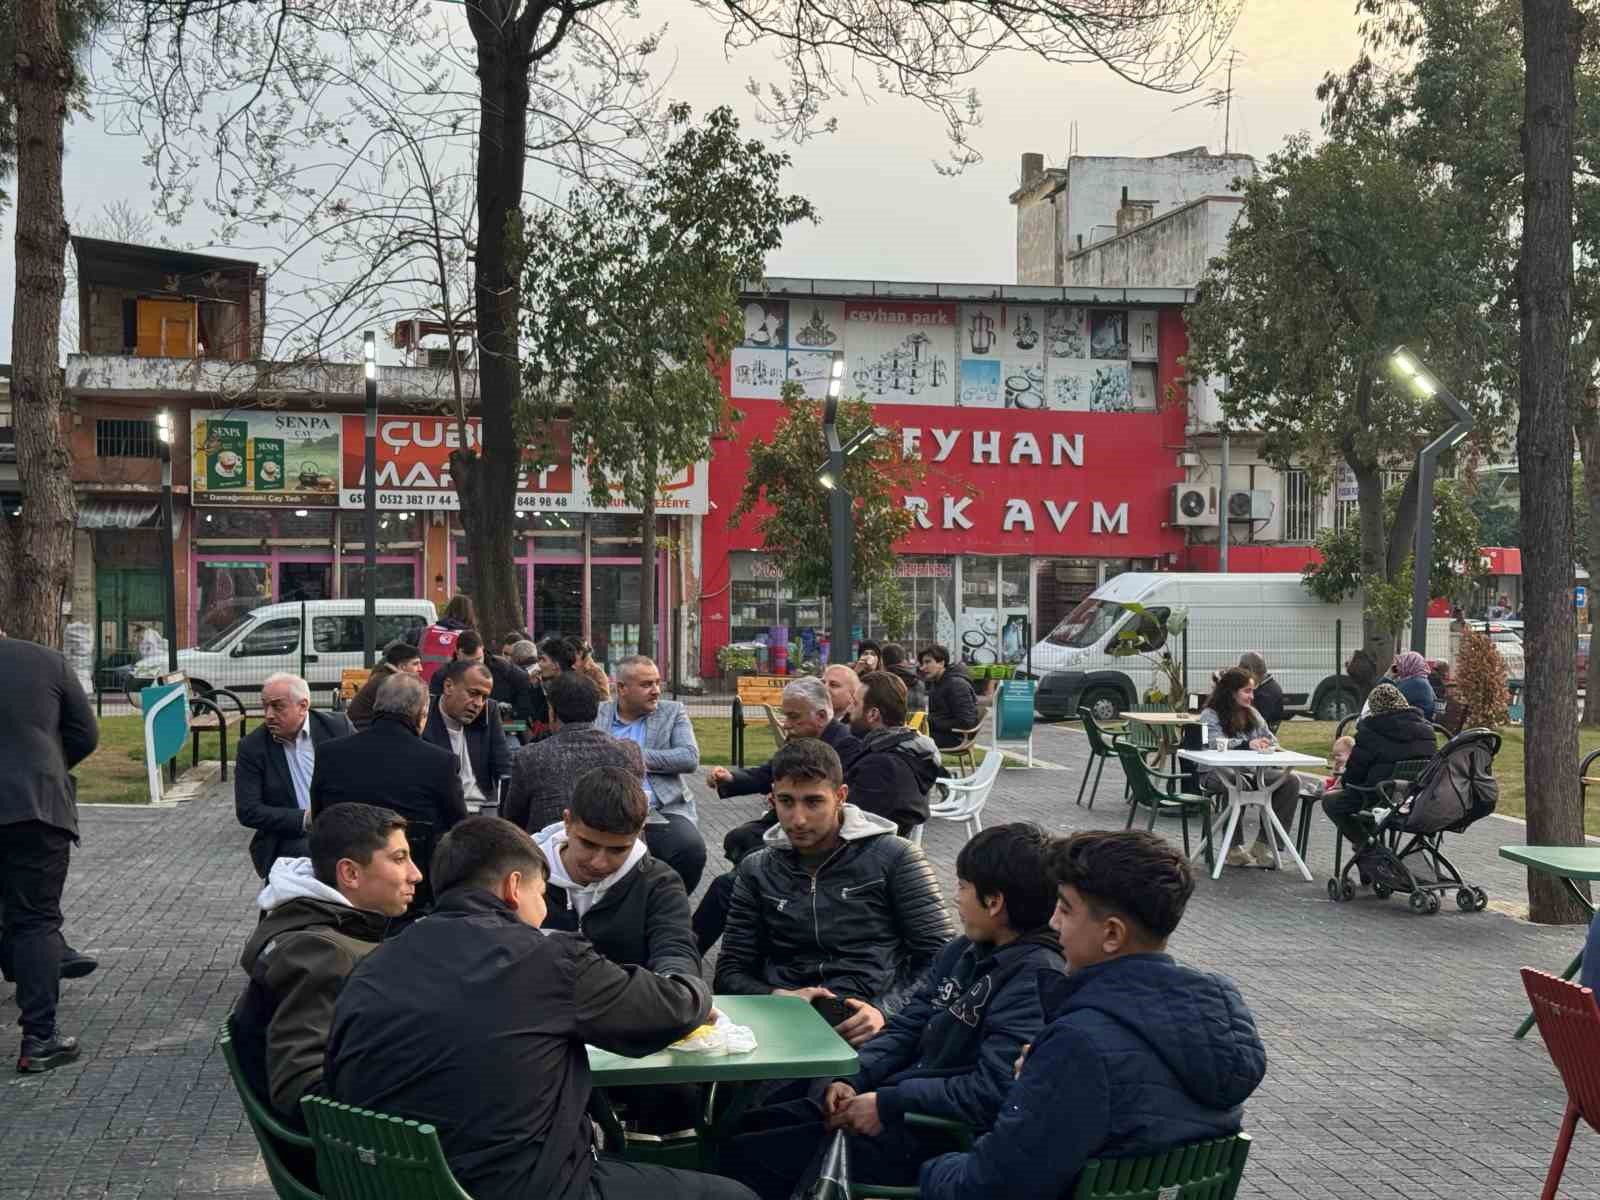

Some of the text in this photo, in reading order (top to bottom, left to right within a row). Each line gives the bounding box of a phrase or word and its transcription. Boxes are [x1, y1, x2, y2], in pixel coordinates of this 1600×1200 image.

[849, 307, 947, 329] ceyhan park
[902, 427, 1085, 466] EYHAN
[350, 494, 367, 504] GS
[380, 494, 402, 504] 0532
[406, 495, 423, 505] 382
[426, 495, 435, 505] 17
[439, 495, 451, 505] 44
[517, 497, 536, 507] 848
[555, 498, 567, 507] 48
[655, 499, 690, 509] EZERYE
[904, 495, 1129, 535] RK AVM
